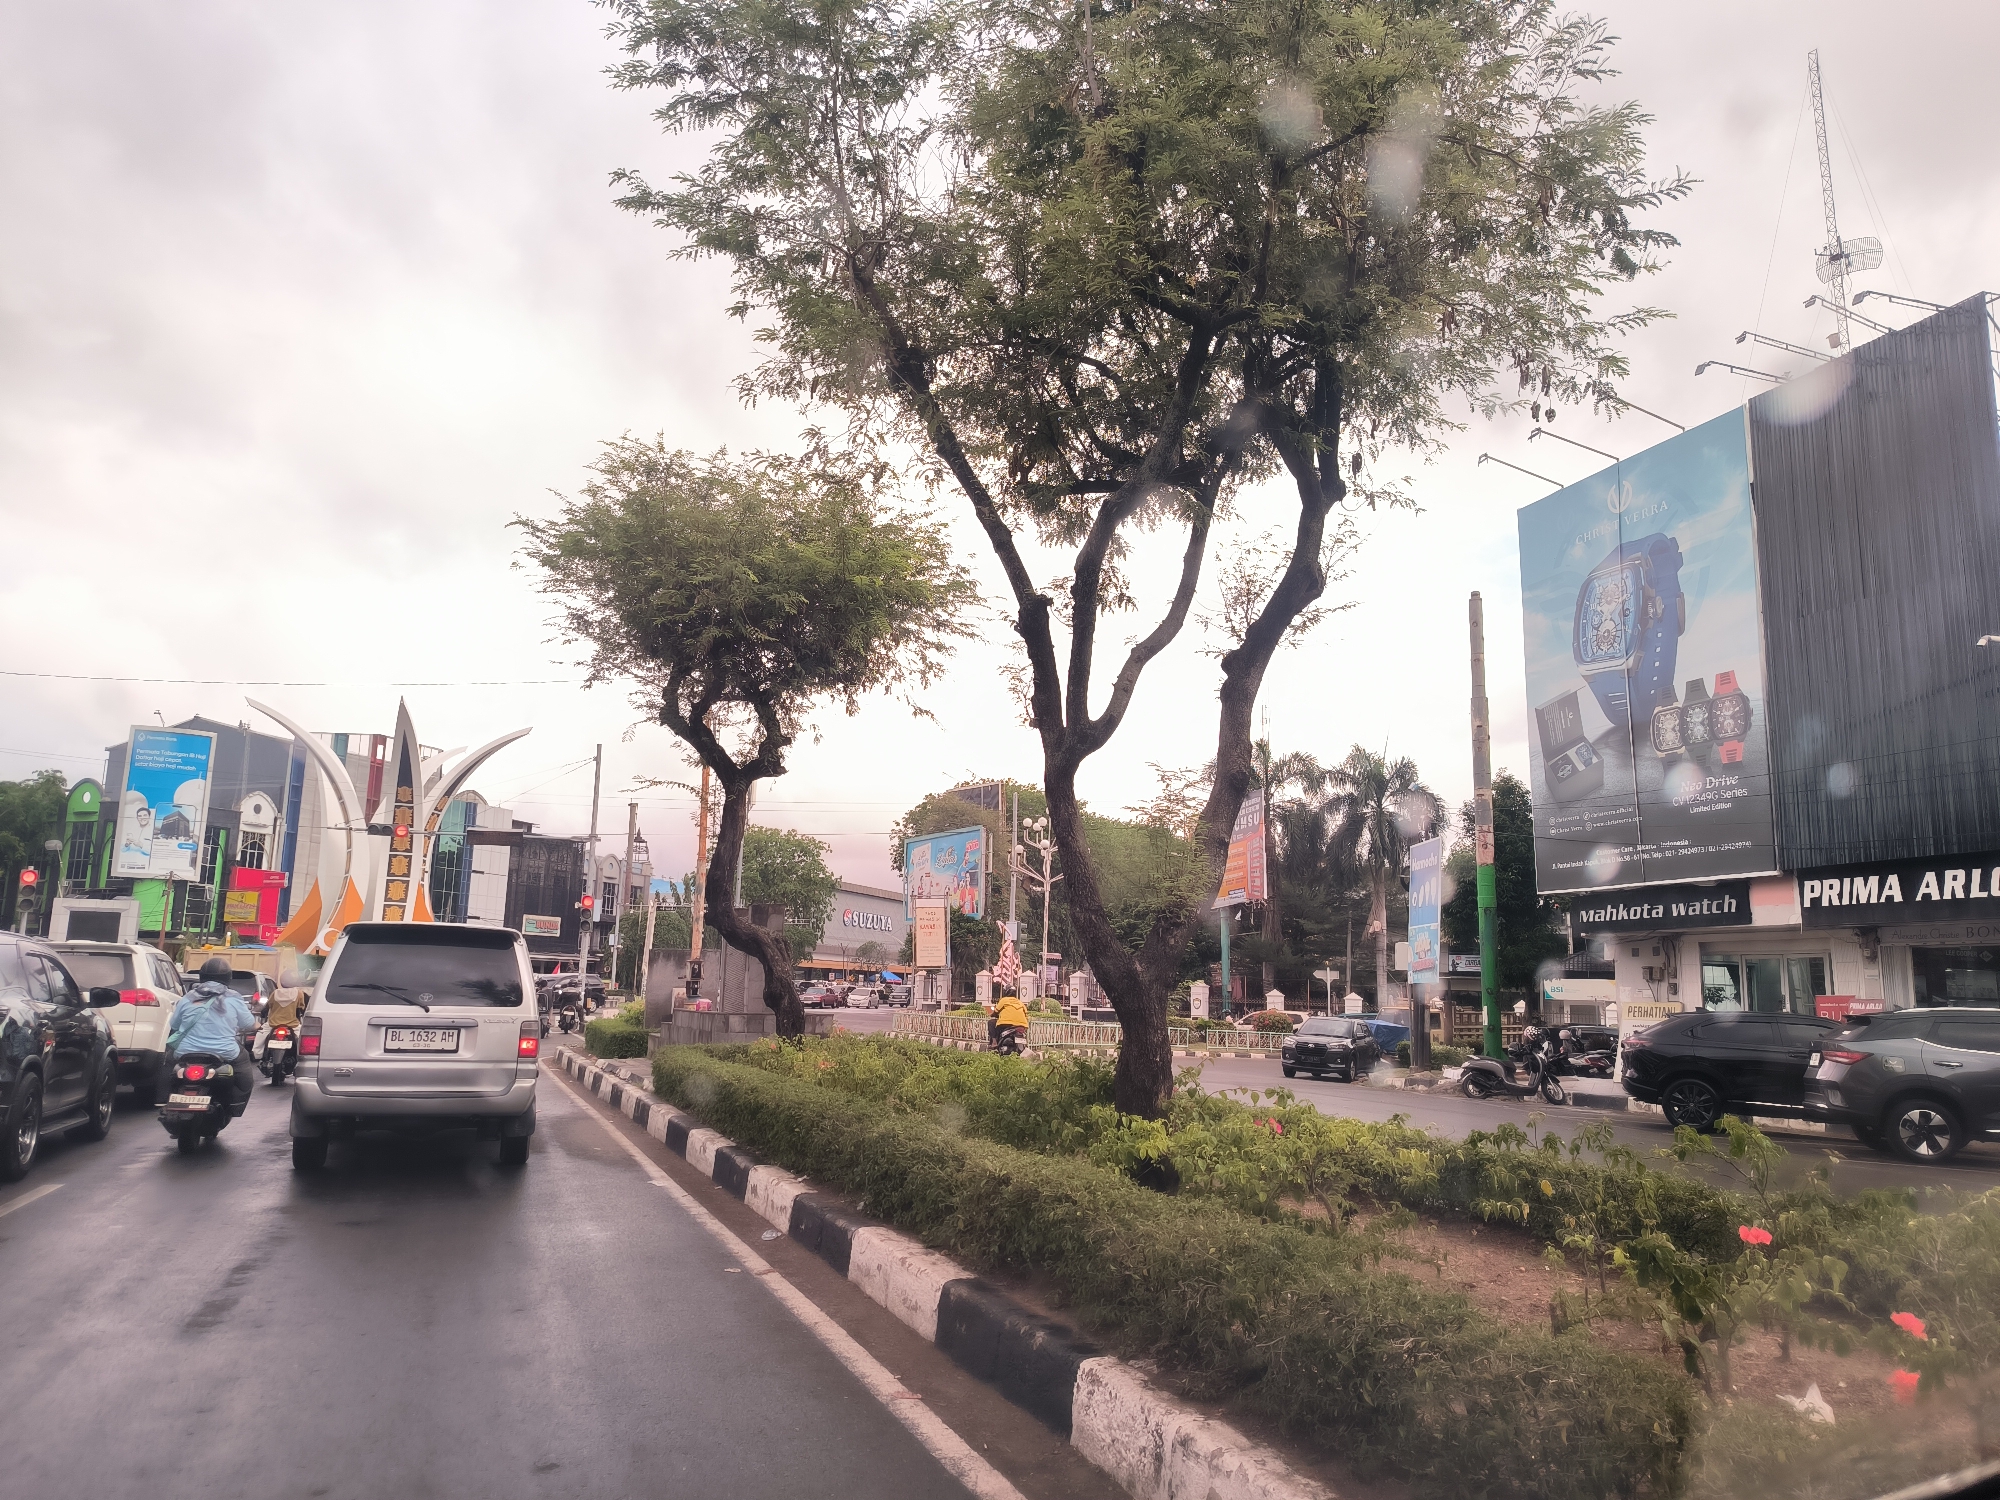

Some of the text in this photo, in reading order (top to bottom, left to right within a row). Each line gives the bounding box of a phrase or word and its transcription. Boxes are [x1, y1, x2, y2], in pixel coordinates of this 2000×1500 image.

[1575, 501, 1669, 545] CHRIST VERRA
[160, 750, 189, 758] Tabungan
[1680, 775, 1739, 793] Neo Drive
[1720, 788, 1748, 799] Series
[1689, 802, 1732, 814] Limited Edition
[1233, 811, 1260, 832] UMSU
[1803, 874, 1904, 908] PRIMA
[1671, 895, 1737, 917] watch
[852, 910, 893, 932] SUZUYA
[1890, 928, 1928, 940] Alexandre
[1929, 928, 1960, 940] Christie
[1956, 949, 1978, 957] COOPER
[390, 1030, 455, 1043] BL 1632 AH
